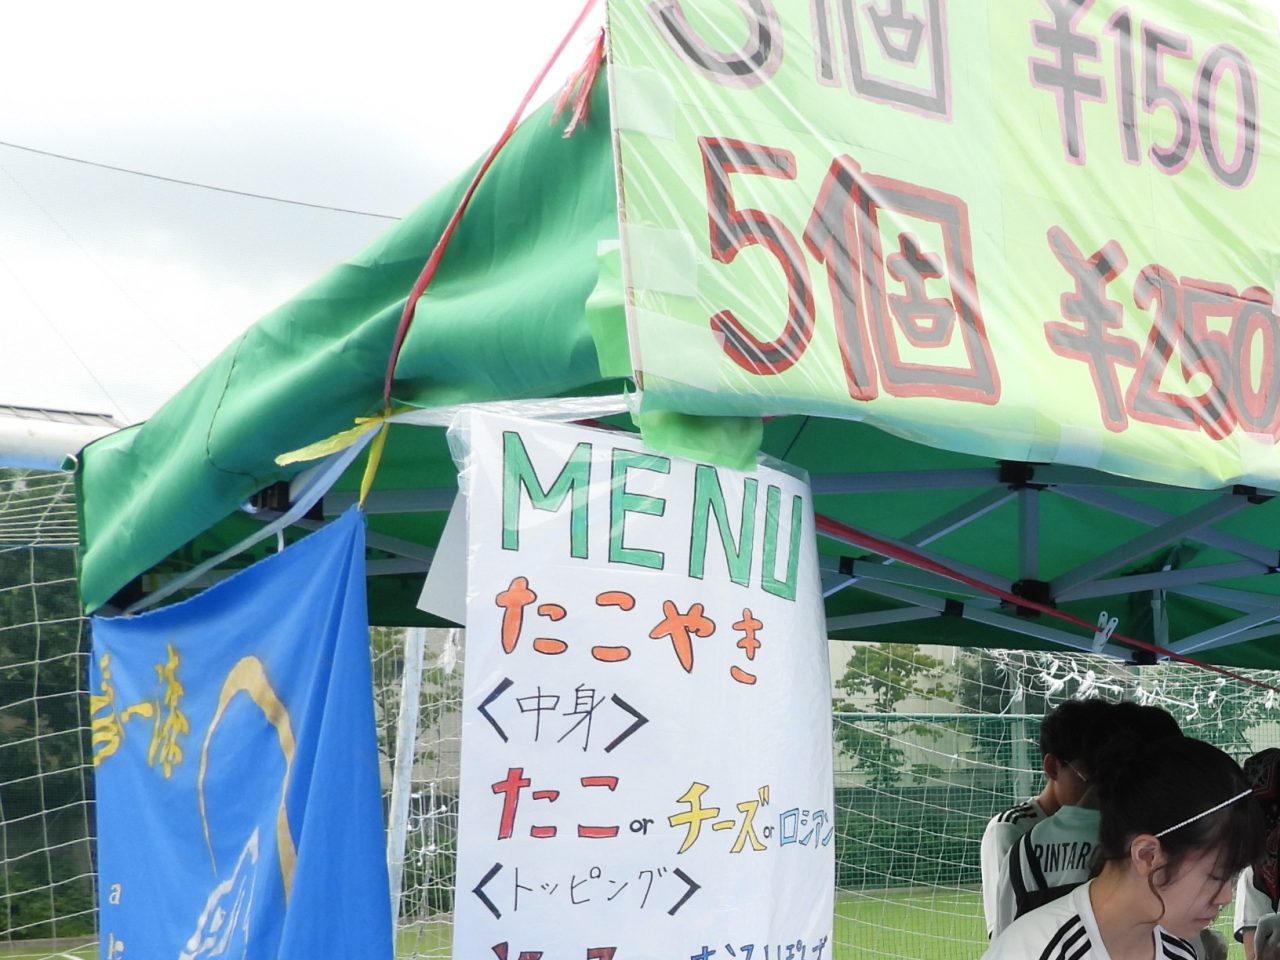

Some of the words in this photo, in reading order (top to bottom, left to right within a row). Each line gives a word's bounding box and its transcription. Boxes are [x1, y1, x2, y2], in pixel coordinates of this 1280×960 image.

[697, 137, 1001, 406] 5個
[501, 431, 803, 602] MENU
[495, 576, 764, 685] たこやき
[491, 768, 620, 840] たこ
[629, 817, 655, 836] or
[668, 782, 771, 855] チーズ
[779, 808, 834, 850] ロシアン
